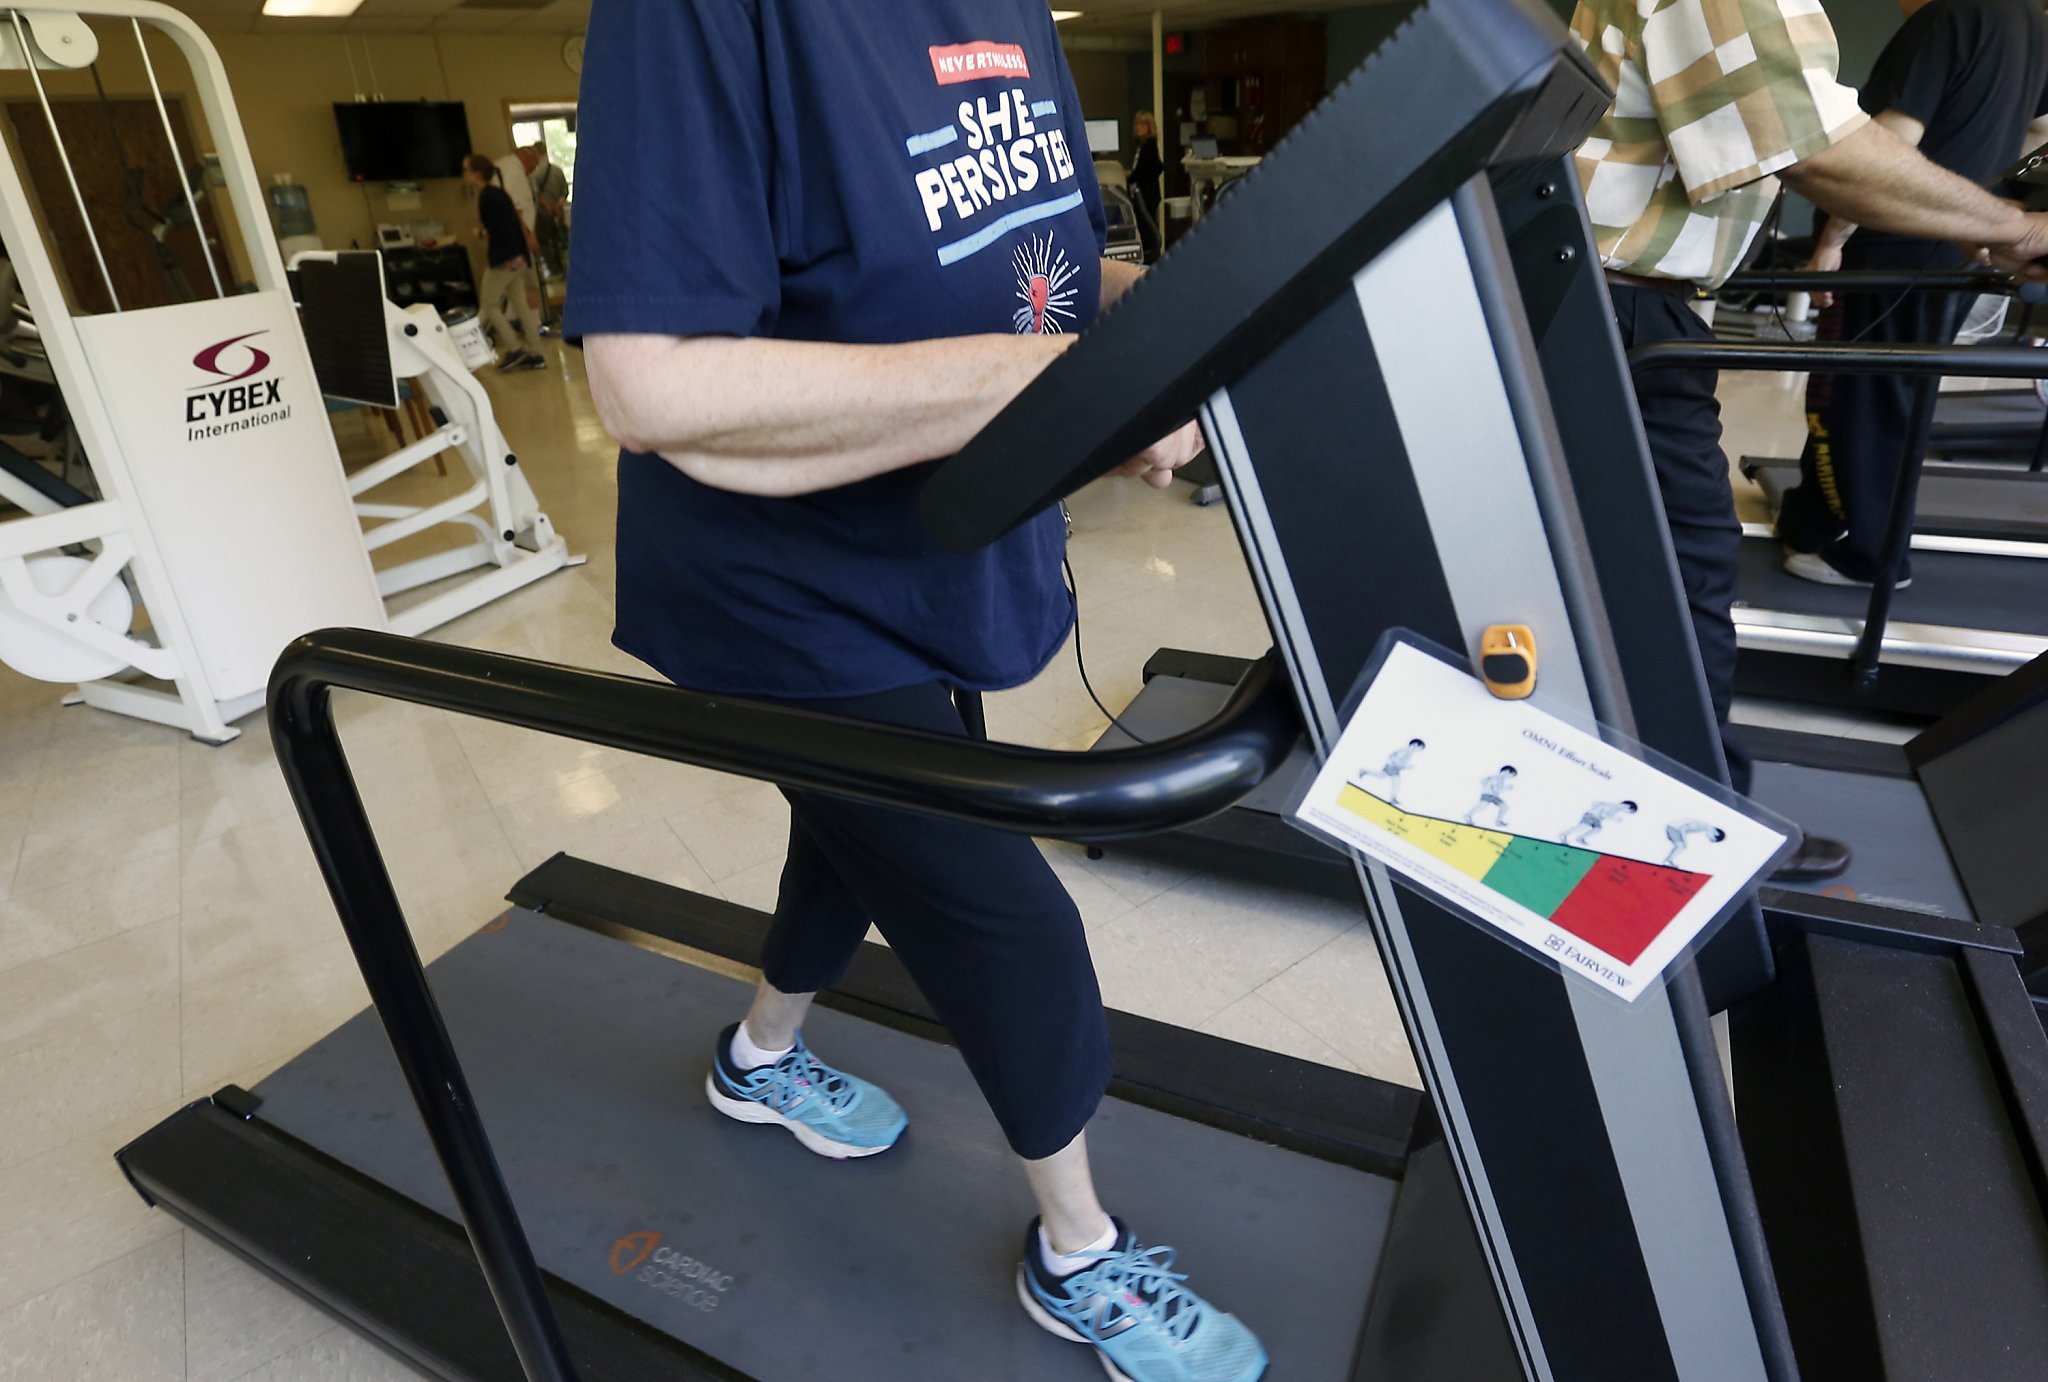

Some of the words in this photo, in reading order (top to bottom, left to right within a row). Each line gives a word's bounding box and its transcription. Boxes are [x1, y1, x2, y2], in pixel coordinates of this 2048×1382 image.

[957, 88, 1036, 150] SHE
[915, 128, 1075, 232] PERSISTED
[186, 378, 281, 423] CYBEX
[188, 404, 291, 441] International
[1522, 729, 1557, 752] OMNI
[1558, 747, 1587, 768] Effort
[1588, 763, 1614, 780] Scale
[1564, 945, 1632, 987] FAIRVIEW
[653, 1246, 735, 1293] CARDIAC
